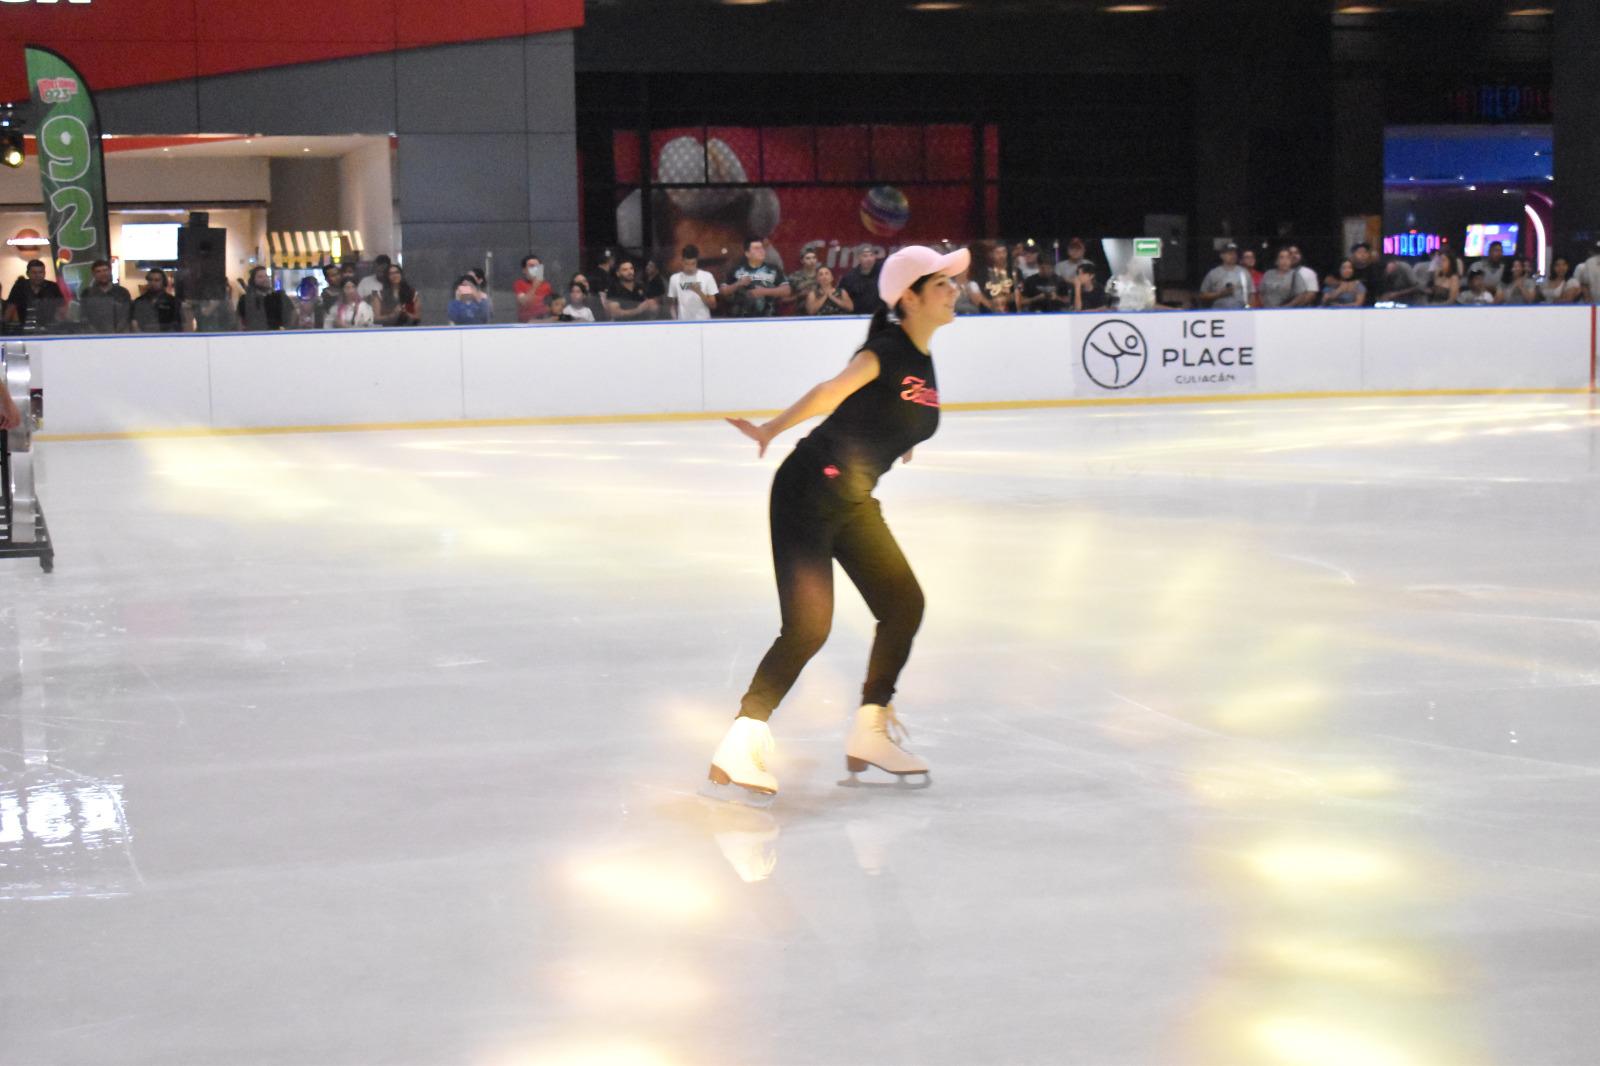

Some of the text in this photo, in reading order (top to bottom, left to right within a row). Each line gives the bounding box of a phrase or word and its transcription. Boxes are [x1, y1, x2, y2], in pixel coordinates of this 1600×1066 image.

[1183, 319, 1225, 338] ICE
[1162, 347, 1254, 367] PLACE
[1175, 372, 1236, 384] CULIACÁN
